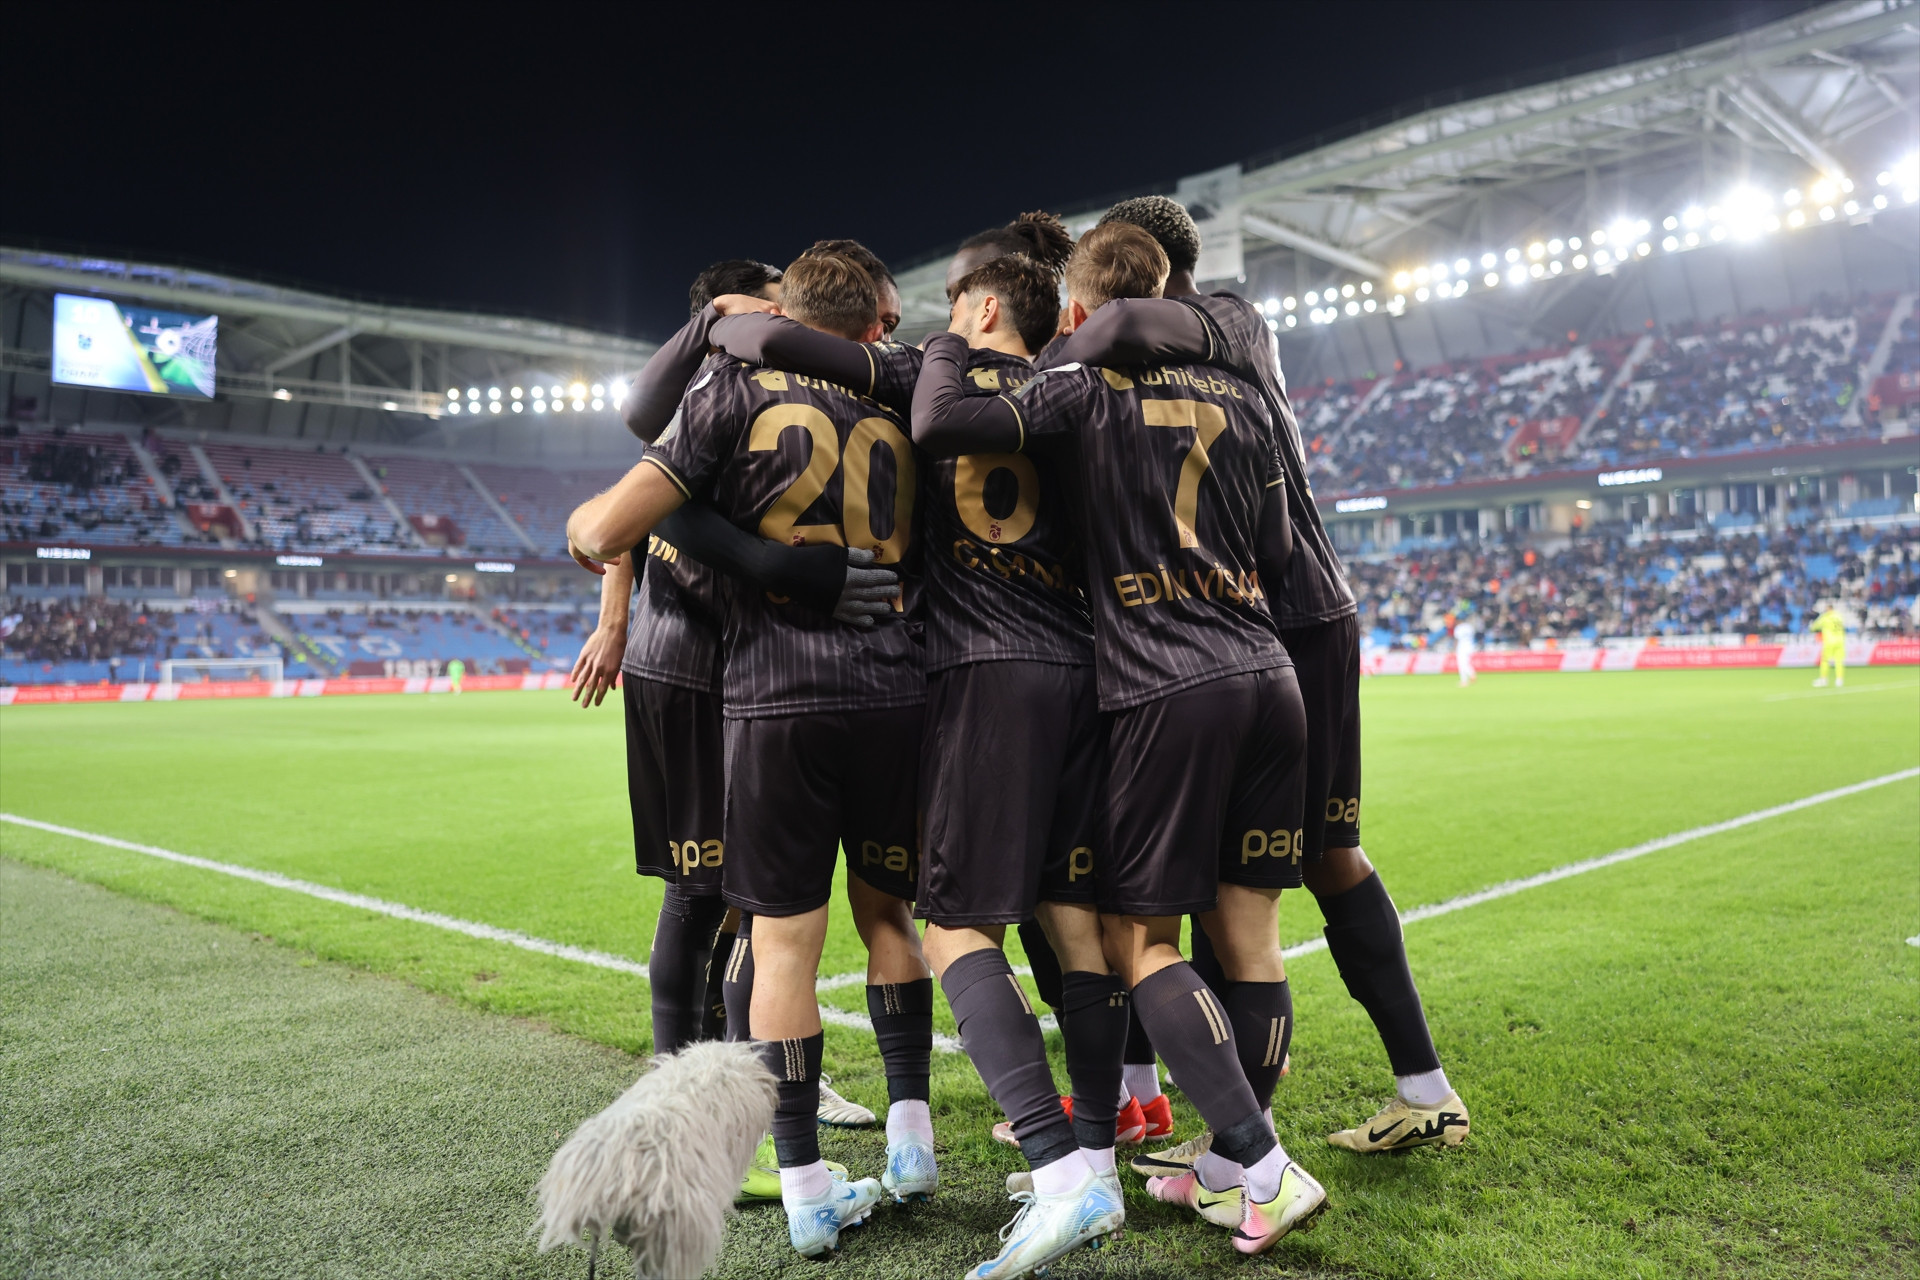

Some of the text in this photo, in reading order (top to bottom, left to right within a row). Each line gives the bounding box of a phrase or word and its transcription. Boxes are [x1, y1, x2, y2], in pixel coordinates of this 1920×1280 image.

[748, 403, 916, 563] 20
[1141, 398, 1227, 549] 7
[36, 547, 91, 560] NISSAN
[1113, 563, 1192, 607] EDİN
